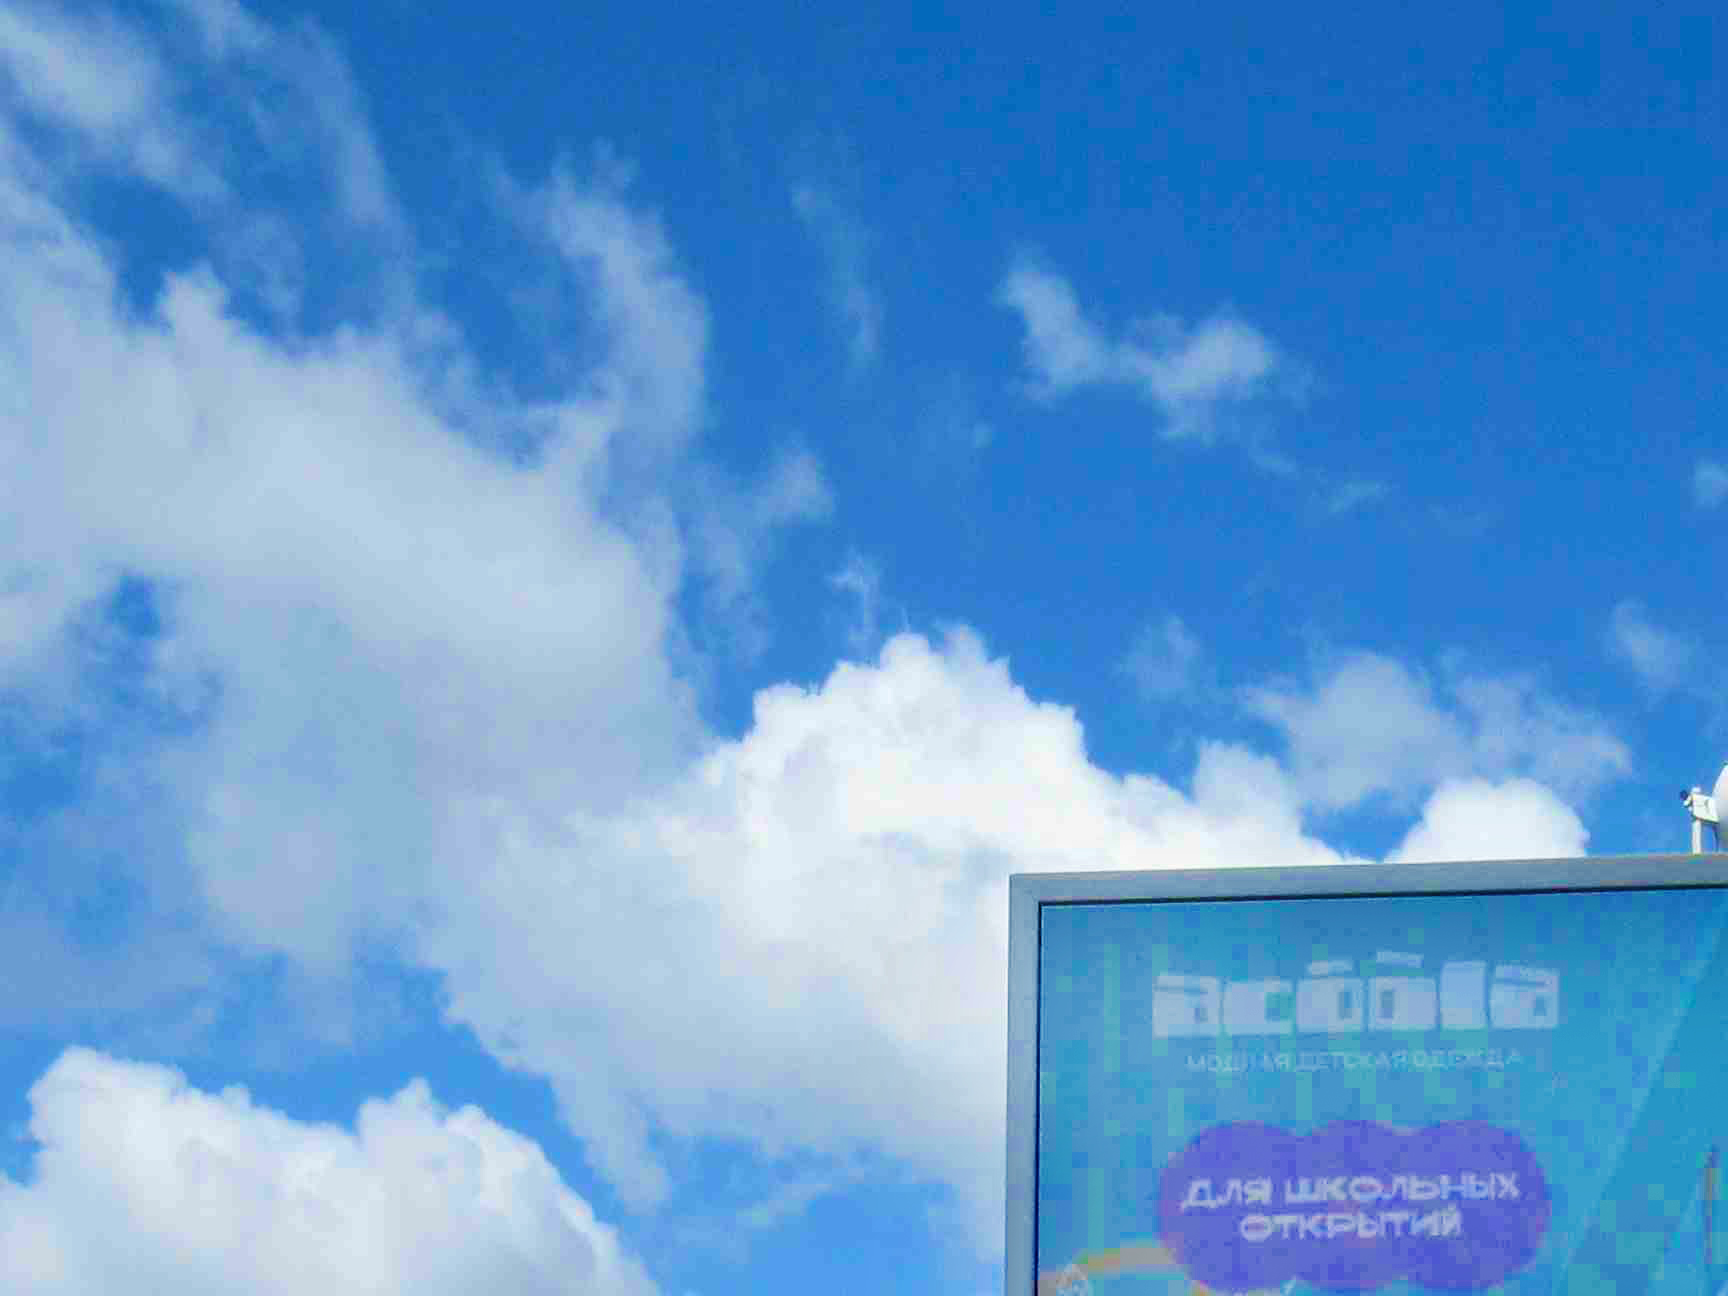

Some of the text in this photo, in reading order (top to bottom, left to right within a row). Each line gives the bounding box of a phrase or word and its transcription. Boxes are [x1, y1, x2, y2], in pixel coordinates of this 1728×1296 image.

[1180, 1171, 1522, 1214] ДЛЯ ШКОЛЬНЫХ
[1239, 1203, 1463, 1242] ОТКРЫТИЙ
